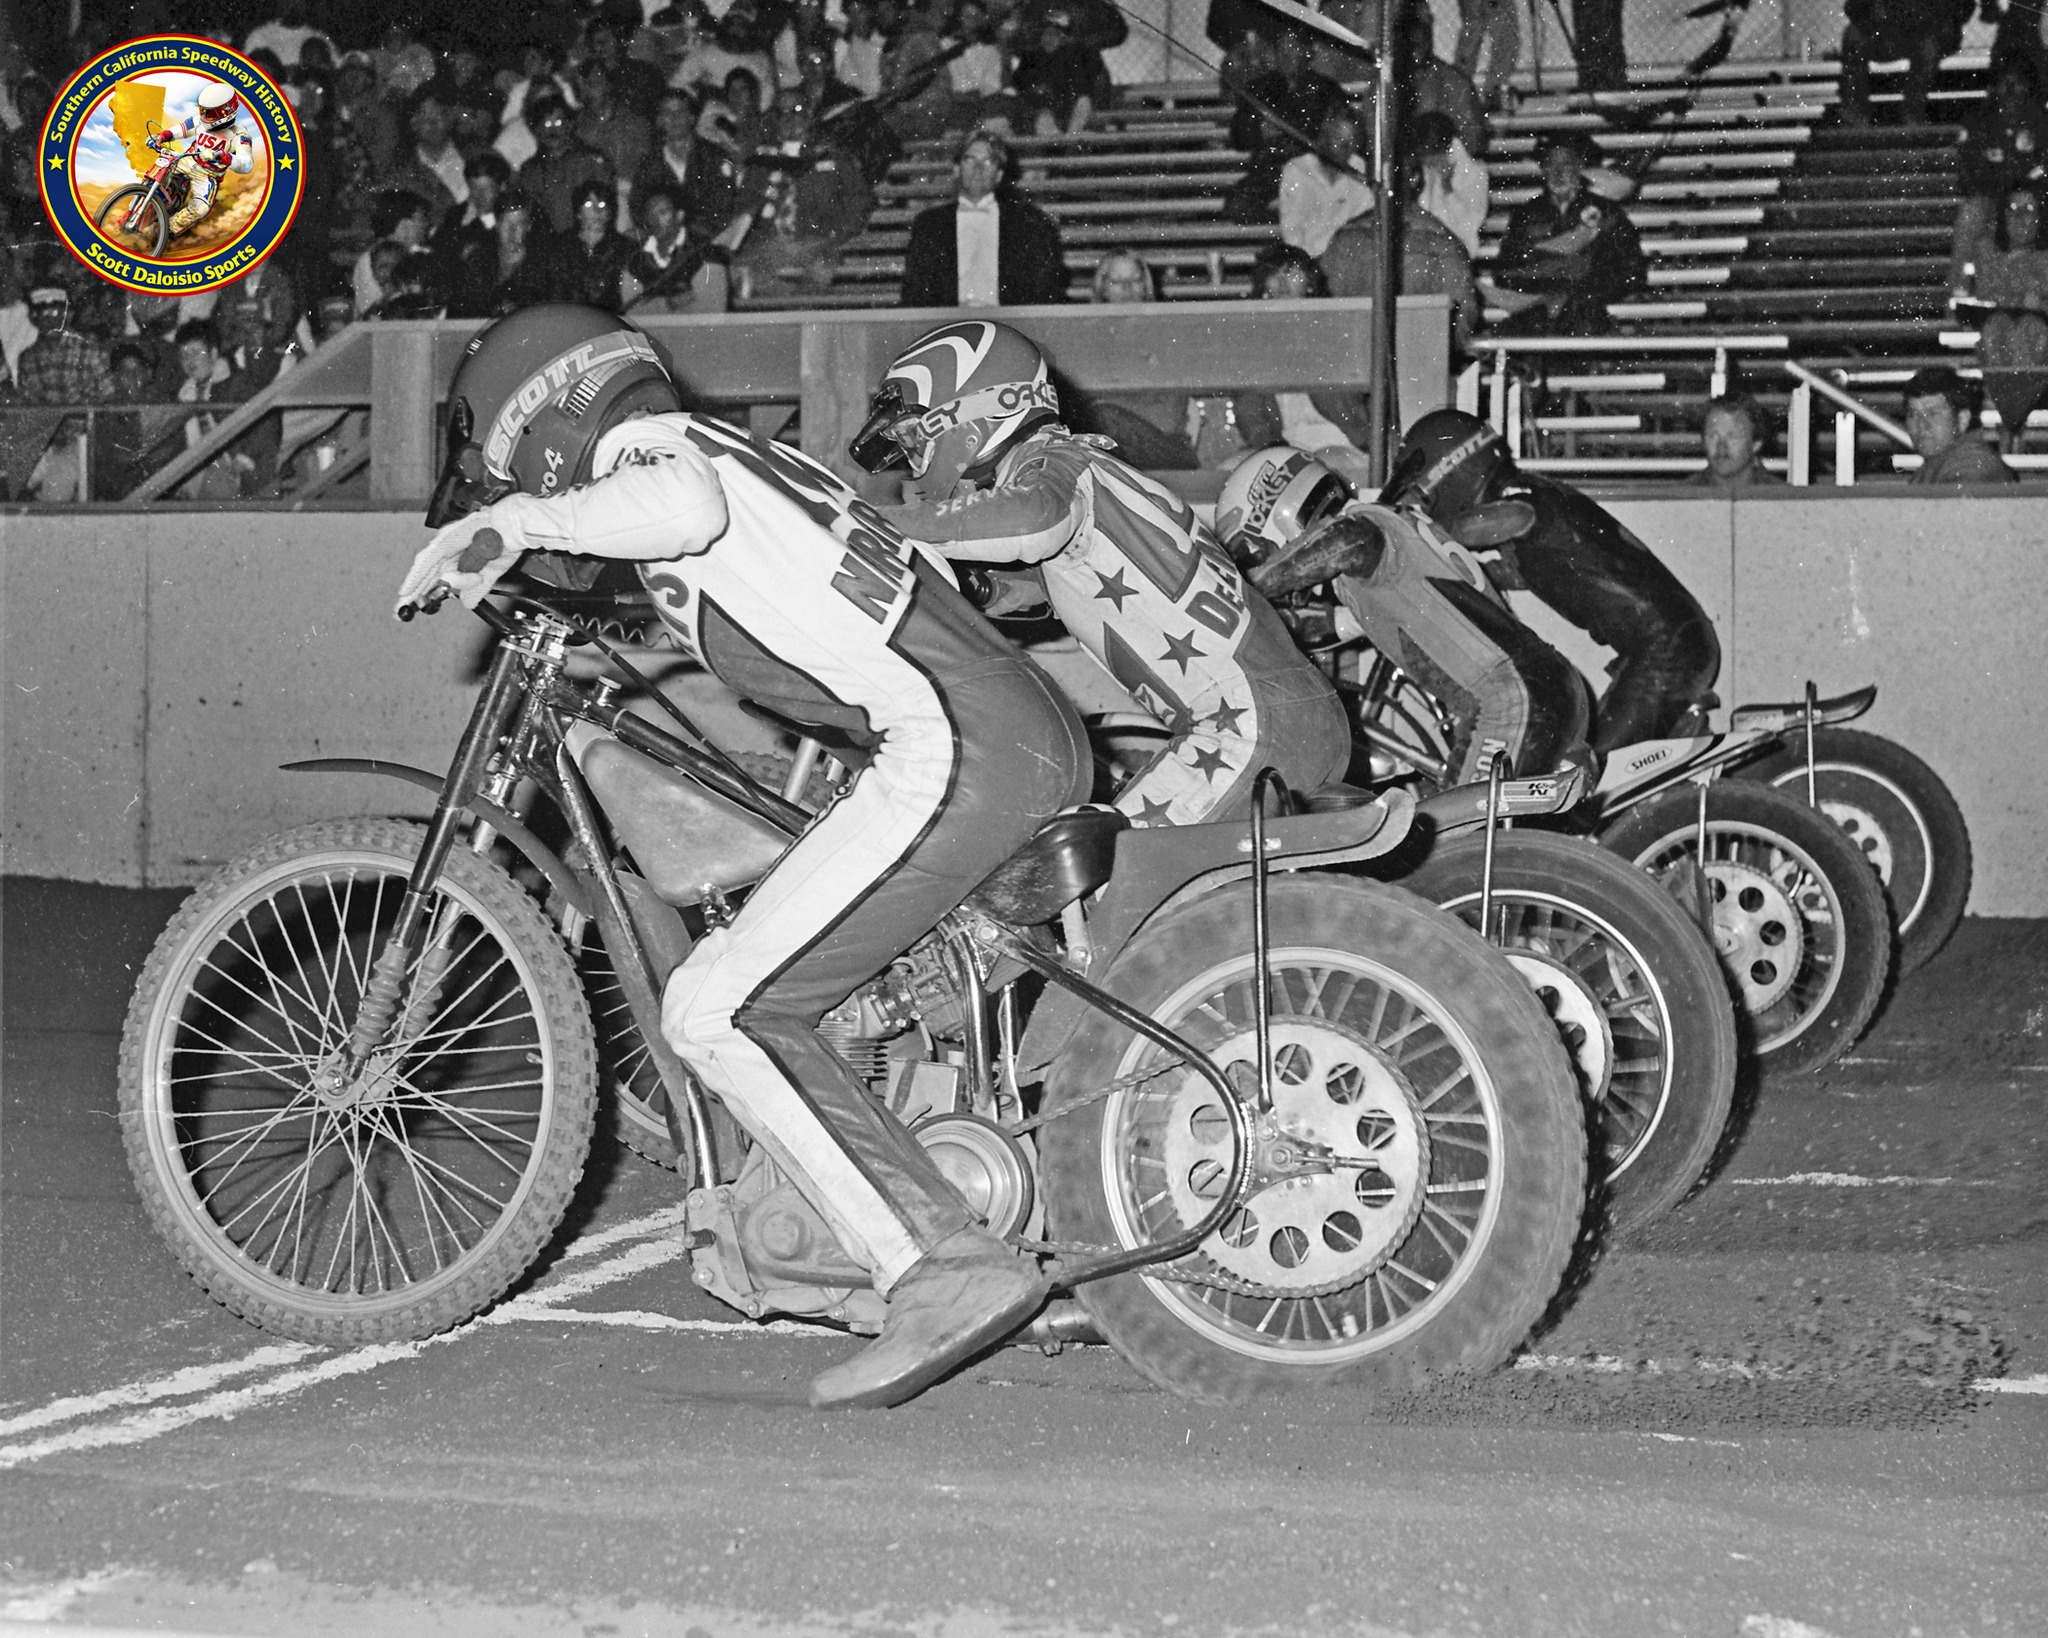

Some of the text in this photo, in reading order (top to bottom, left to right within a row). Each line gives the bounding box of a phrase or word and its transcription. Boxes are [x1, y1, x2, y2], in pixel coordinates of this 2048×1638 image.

[487, 344, 595, 473] SCOTT
[1249, 464, 1294, 528] OAKLEY
[1630, 750, 1668, 770] SHOEI
